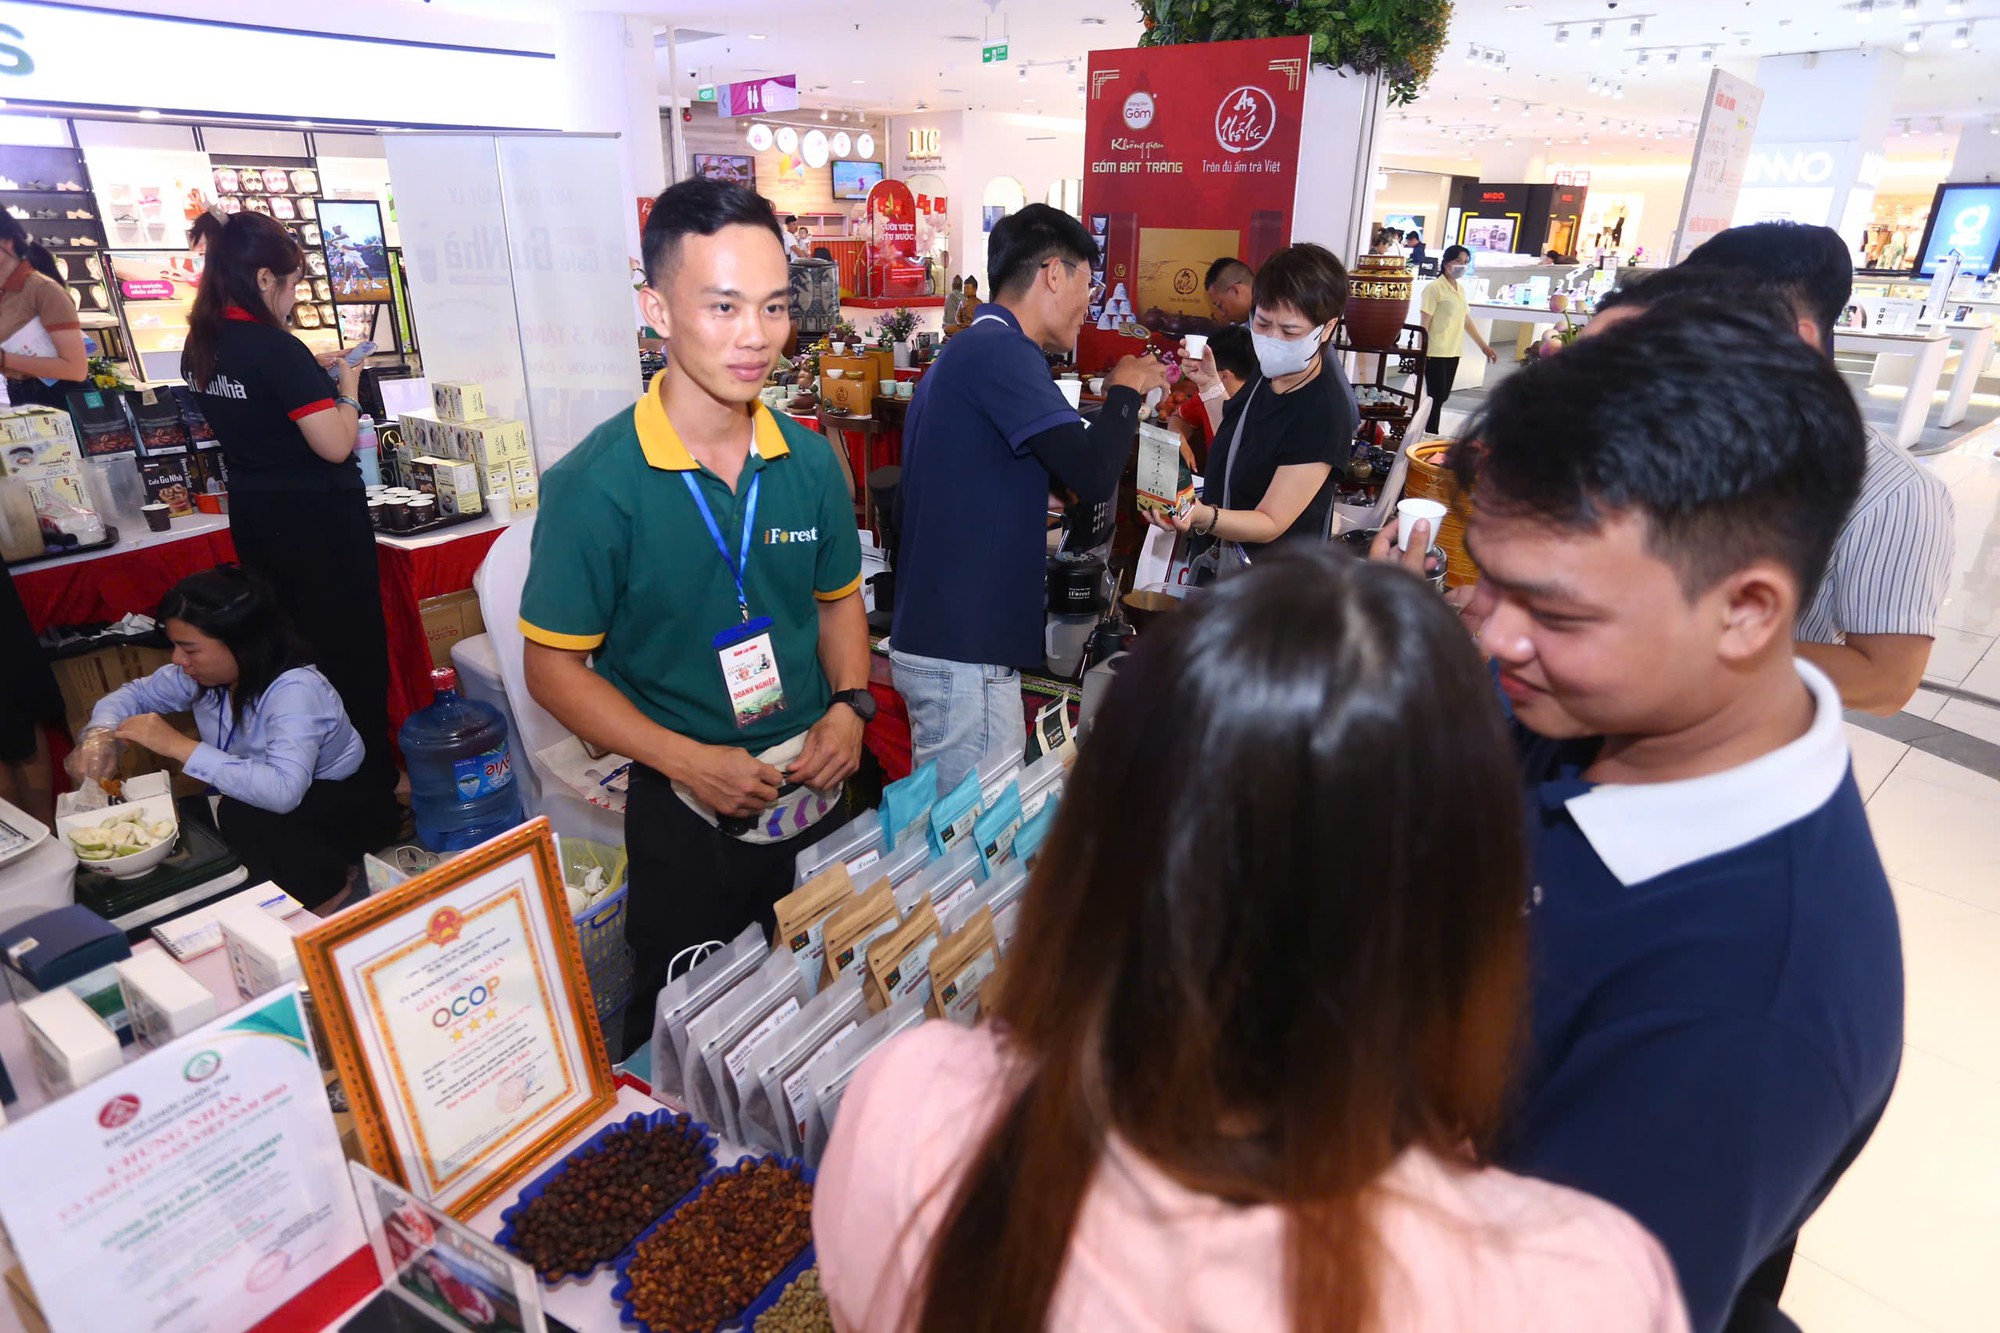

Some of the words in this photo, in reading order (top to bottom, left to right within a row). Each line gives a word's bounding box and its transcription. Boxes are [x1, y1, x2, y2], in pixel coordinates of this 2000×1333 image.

[1125, 107, 1151, 119] Gốm
[1111, 138, 1145, 158] Không
[1202, 161, 1220, 173] Tròn
[1249, 161, 1262, 172] trà
[1264, 160, 1281, 173] Việt
[1483, 192, 1505, 200] MIDO
[764, 527, 818, 544] iForest
[733, 686, 755, 700] DOANH
[754, 677, 776, 692] NGHIỆP
[432, 975, 501, 1028] OCOP
